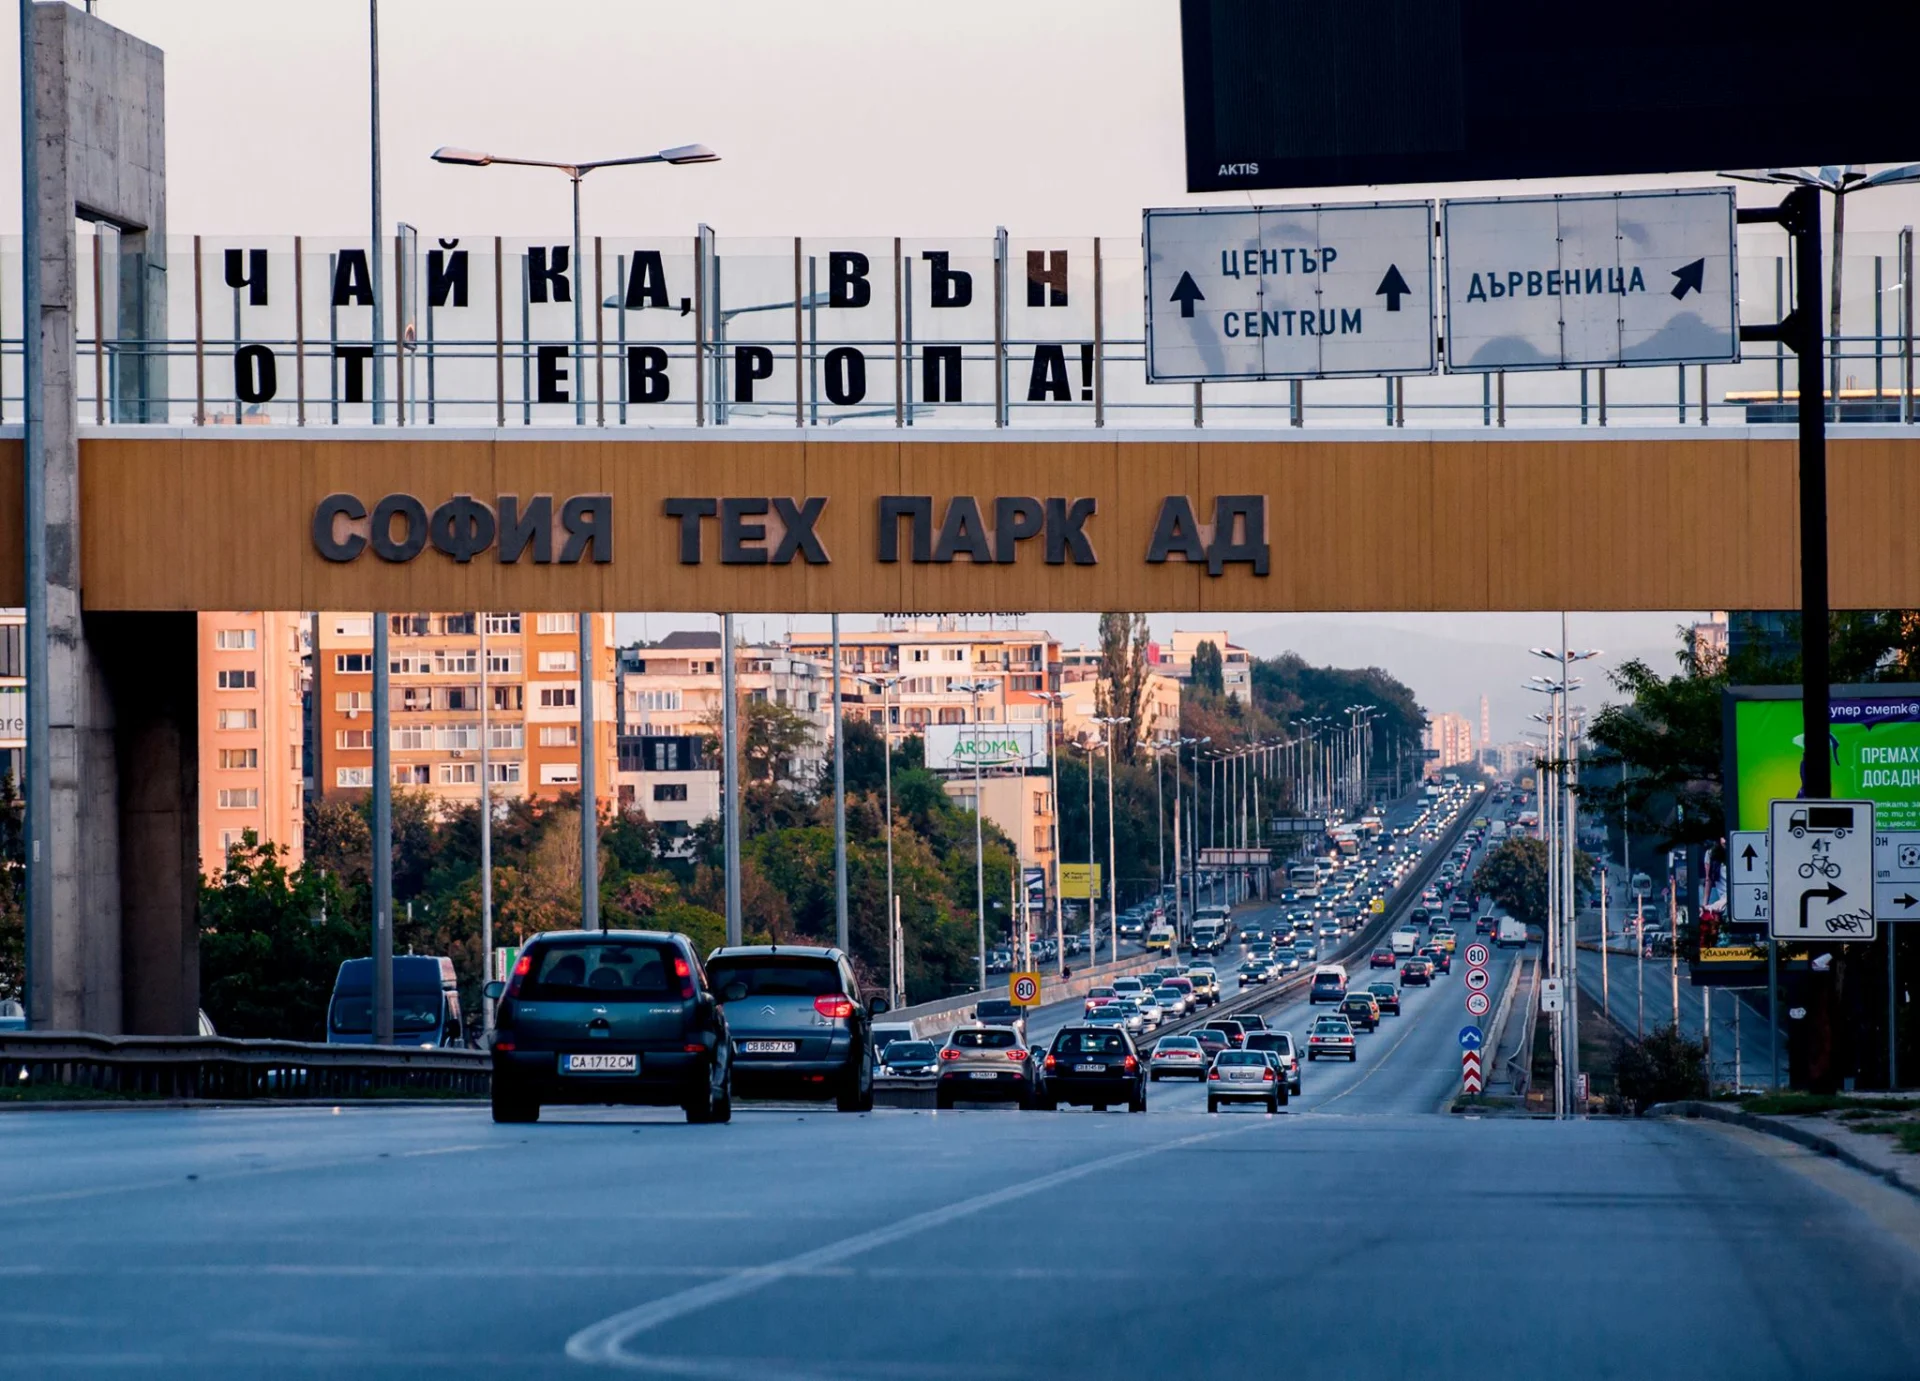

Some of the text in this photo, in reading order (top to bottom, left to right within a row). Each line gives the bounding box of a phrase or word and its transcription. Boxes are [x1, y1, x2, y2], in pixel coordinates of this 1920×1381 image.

[1218, 163, 1259, 175] AKTIS
[1221, 247, 1338, 279] ЦЕНТЪР
[224, 238, 1068, 317] ЧАЙКА, ВЪН
[1466, 265, 1646, 303] ДЪРВЕНИЦА
[1223, 308, 1363, 338] CENTRUM
[234, 344, 1095, 406] ОТ ЕВРОПА!
[312, 493, 1271, 577] СОФИЯ ТЕХ ПАРК АД
[1830, 705, 1861, 718] упер
[953, 740, 1019, 755] AROMA
[1470, 950, 1484, 962] 80
[1018, 982, 1033, 996] 80
[571, 1056, 634, 1068] CA 1712 CM
